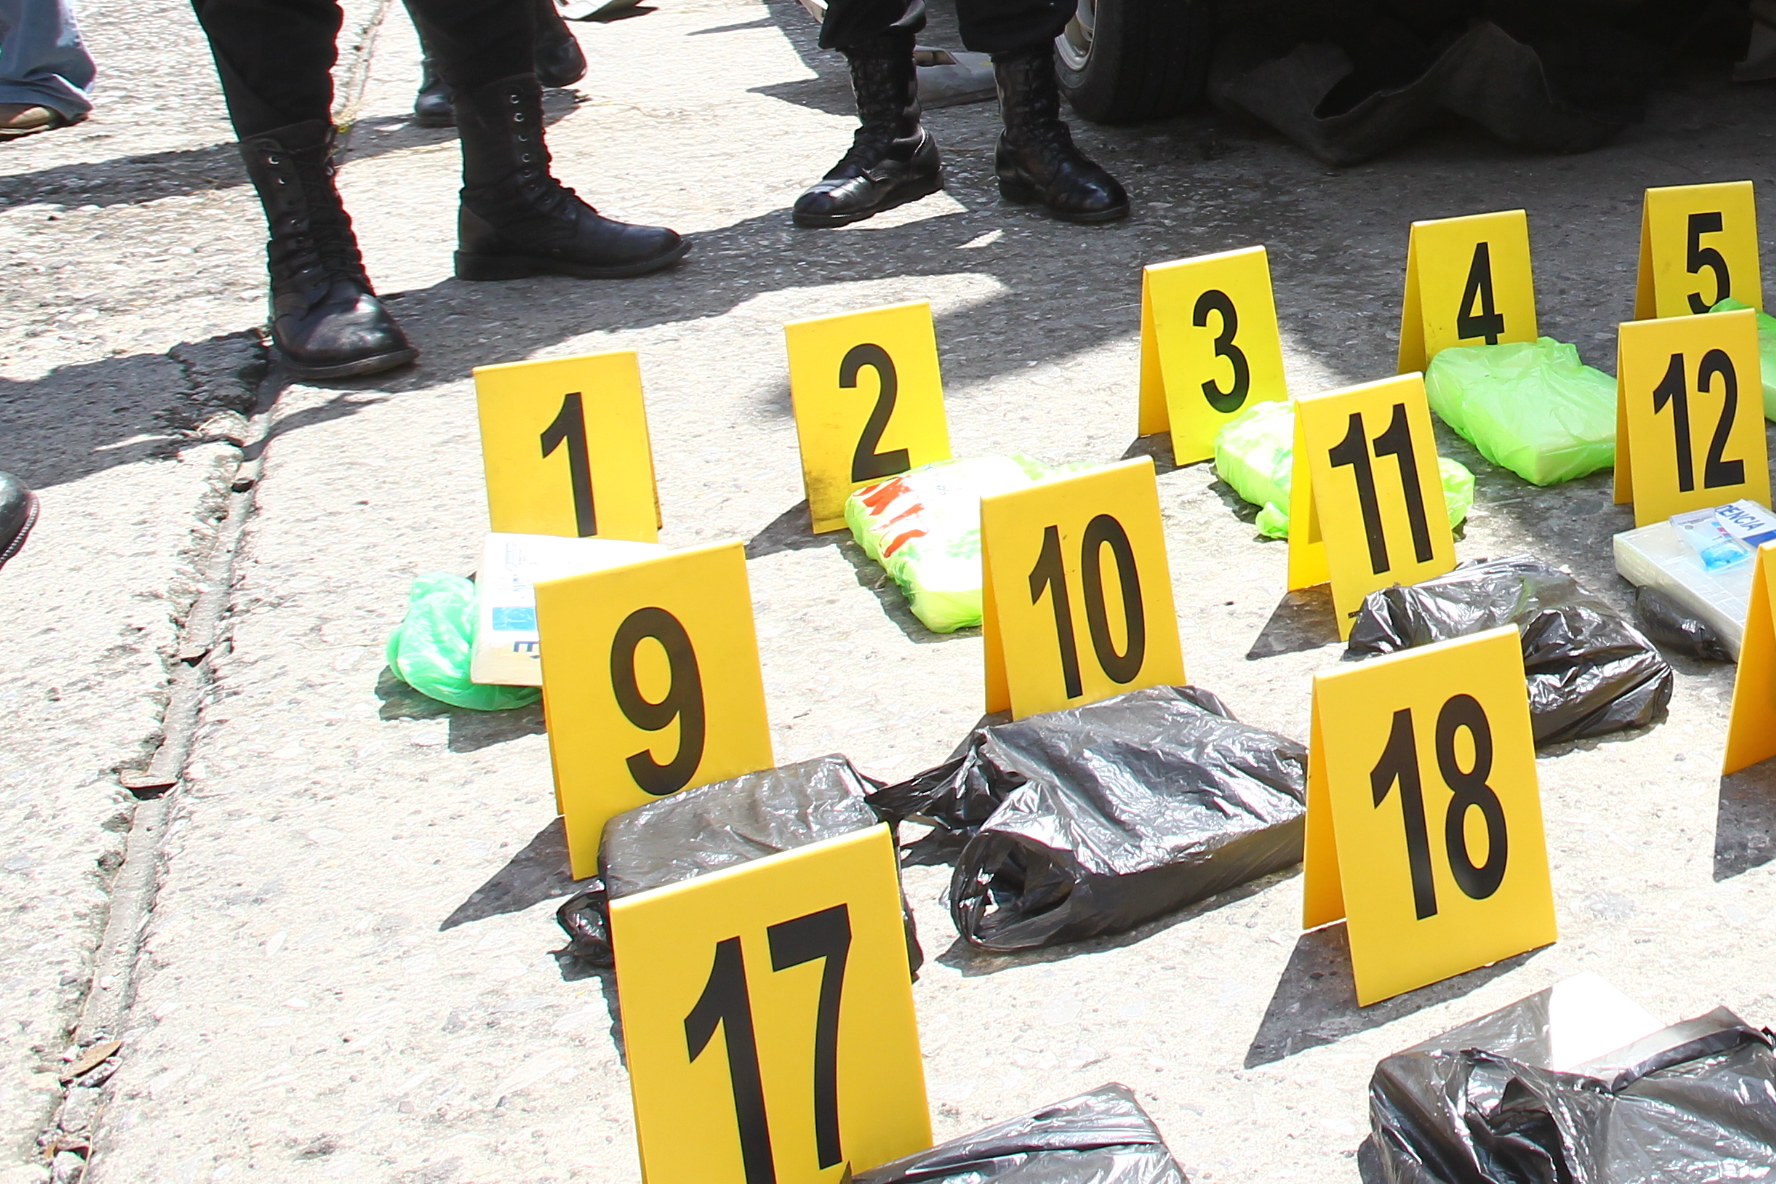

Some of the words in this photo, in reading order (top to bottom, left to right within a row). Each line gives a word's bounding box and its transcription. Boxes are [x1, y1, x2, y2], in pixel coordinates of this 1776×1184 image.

[1457, 242, 1504, 345] 4
[1686, 212, 1731, 314] 5
[839, 343, 911, 483] 2
[1193, 290, 1250, 413] 3
[1652, 349, 1745, 493] 12
[541, 393, 597, 538] 1
[1328, 404, 1433, 575] 11
[1029, 515, 1146, 700] 10
[611, 607, 705, 797] 9
[1370, 693, 1508, 921] 18
[684, 903, 852, 1184] 17
